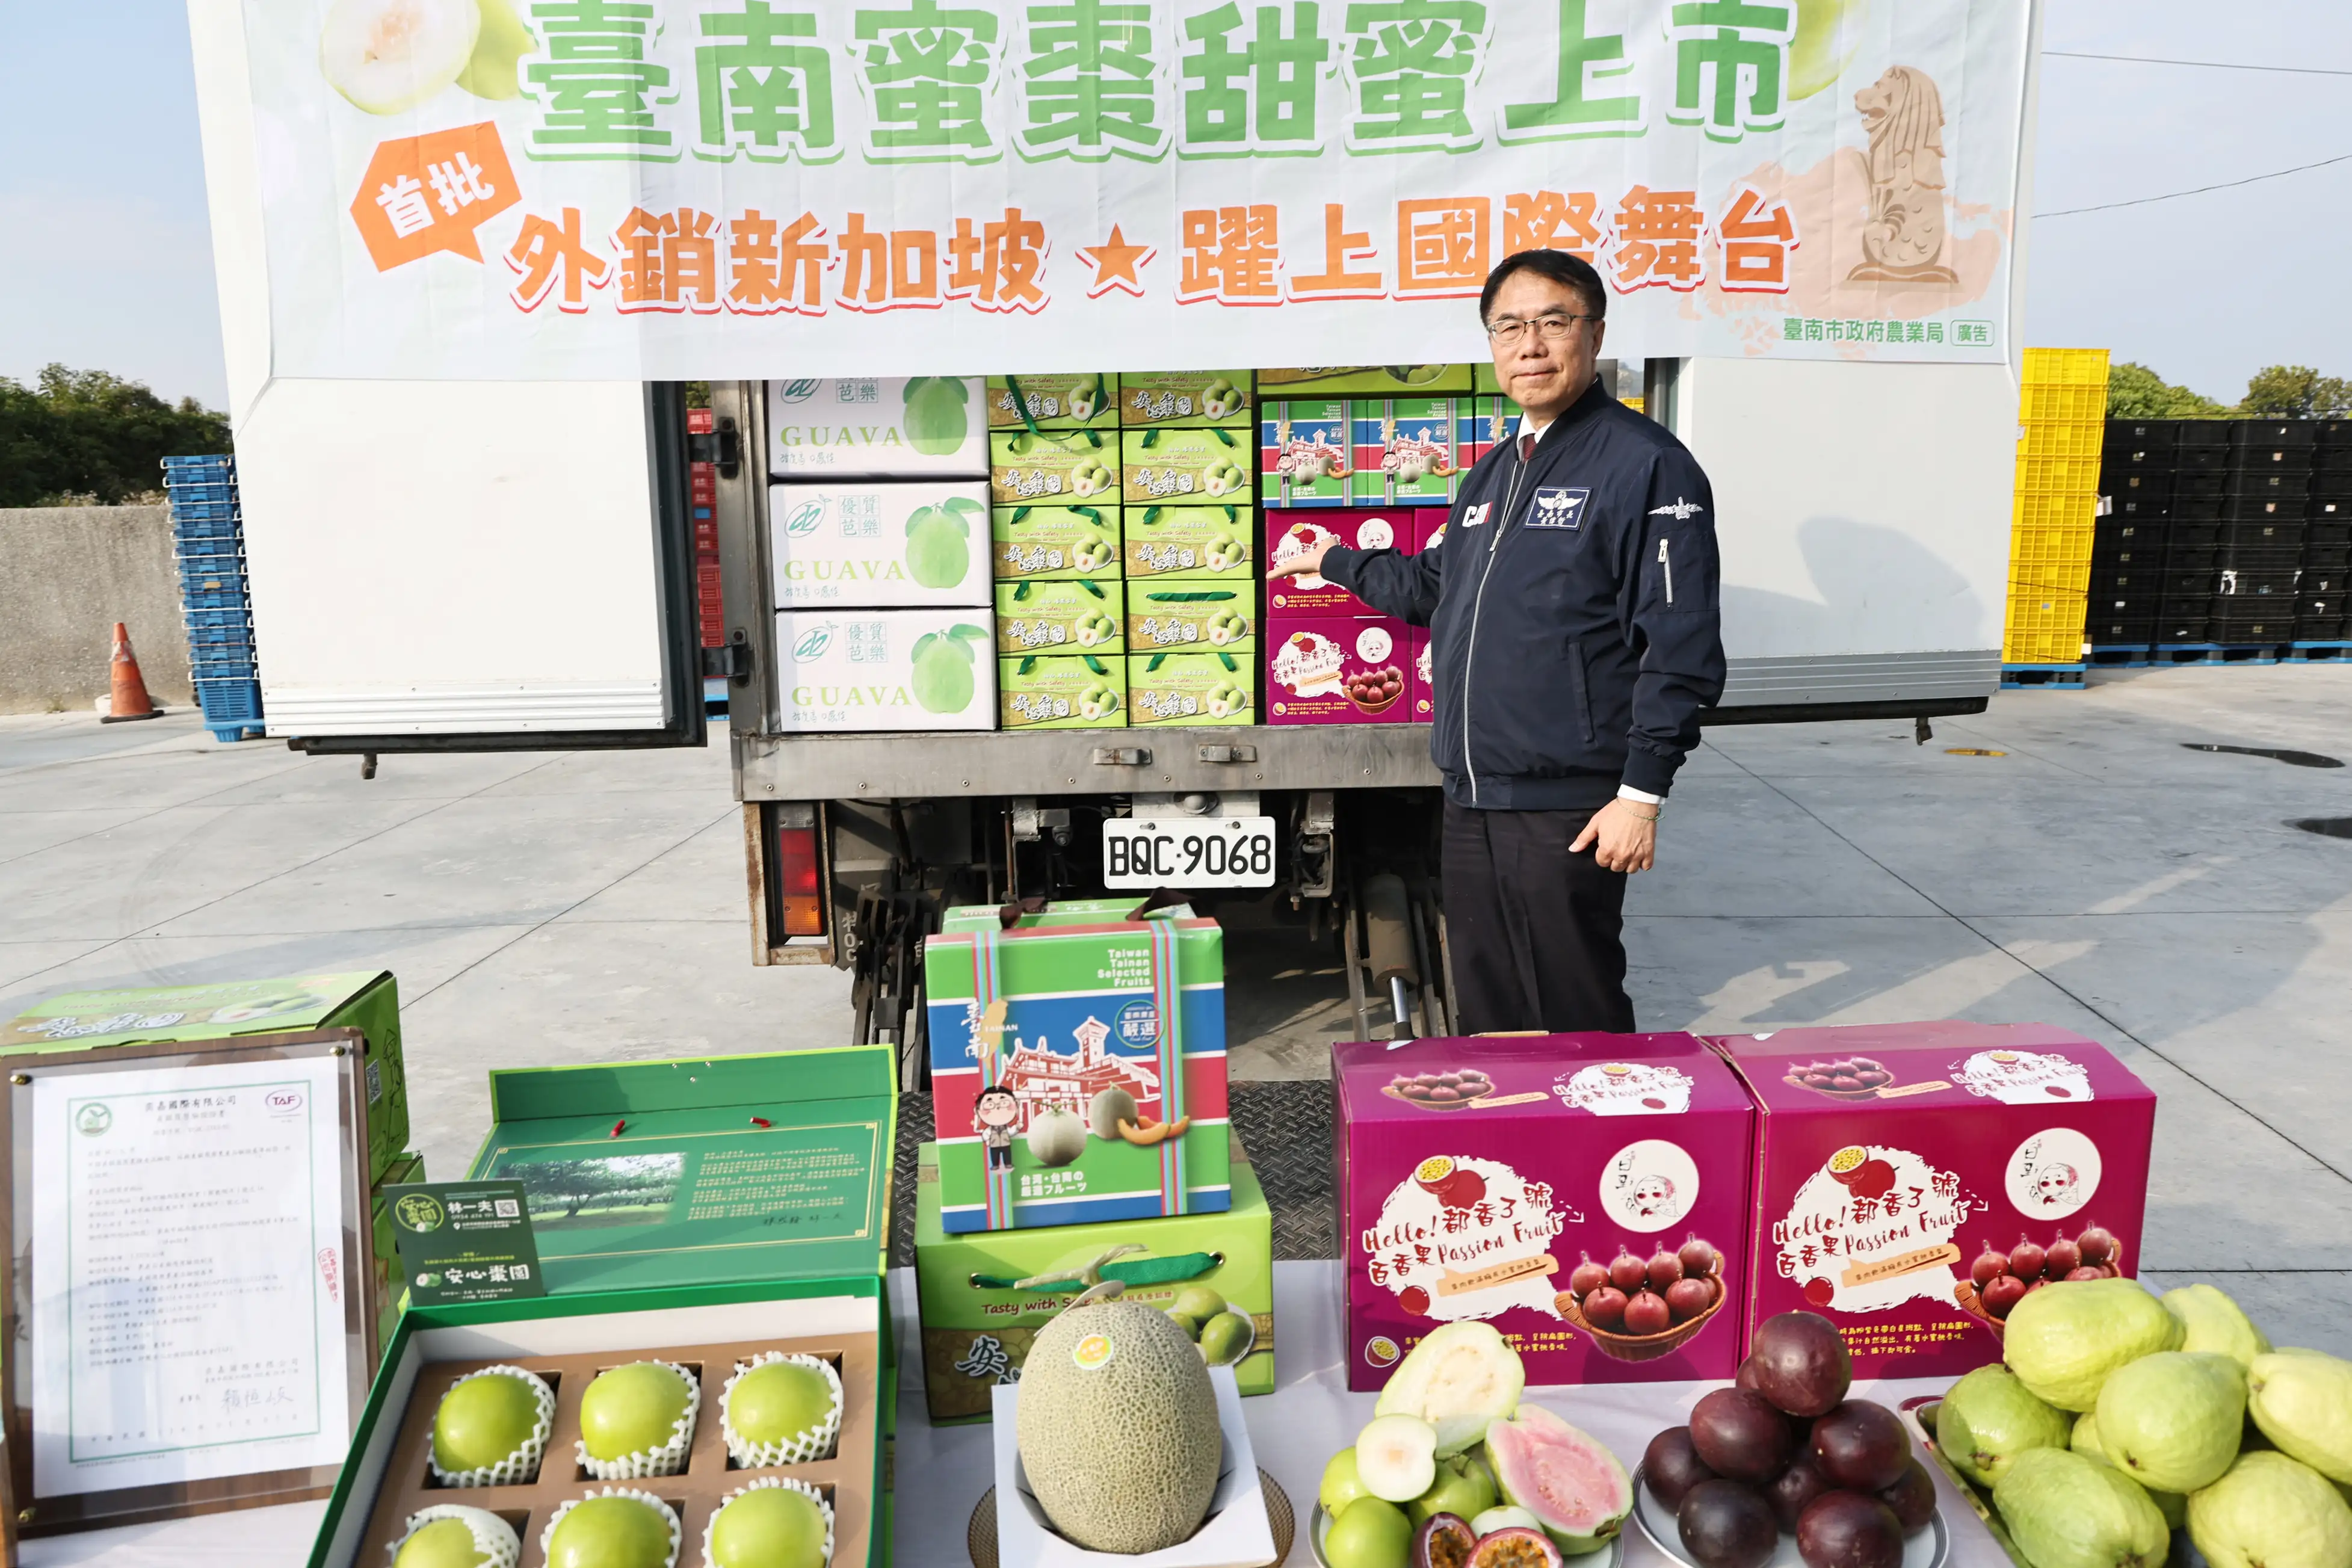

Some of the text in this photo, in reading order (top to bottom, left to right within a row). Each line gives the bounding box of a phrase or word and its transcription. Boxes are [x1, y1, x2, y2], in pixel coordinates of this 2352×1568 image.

[519, 0, 1794, 164] 臺南蜜棗甜蜜上市
[374, 152, 495, 239] 首批
[504, 185, 1800, 316] 外銷新加坡 躍上國際舞台
[1783, 318, 1989, 343] 臺南市政府農業局 廣告
[839, 384, 876, 401] 芭樂
[780, 426, 903, 446] GUAVA
[842, 519, 879, 536] 芭樂
[784, 561, 906, 581] GUAVA
[849, 644, 886, 661] 芭樂
[1273, 656, 1298, 669] Hello!
[792, 686, 912, 706] GUAVA
[1108, 949, 1150, 959] Taiwan
[1110, 958, 1150, 968] Tainan
[1097, 968, 1150, 978] Selected
[1114, 978, 1151, 987] Fruits
[273, 1096, 296, 1107] TAF
[1365, 1215, 1437, 1251] Hello!
[1775, 1204, 1846, 1244] Hello!
[1370, 1214, 1564, 1285] 百香果 Passion Fruit
[1777, 1202, 1969, 1277] 百香果 Passion Fruit
[445, 1264, 529, 1284] 安心棗園
[981, 1304, 1019, 1315] Tasty
[1025, 1298, 1057, 1311] with
